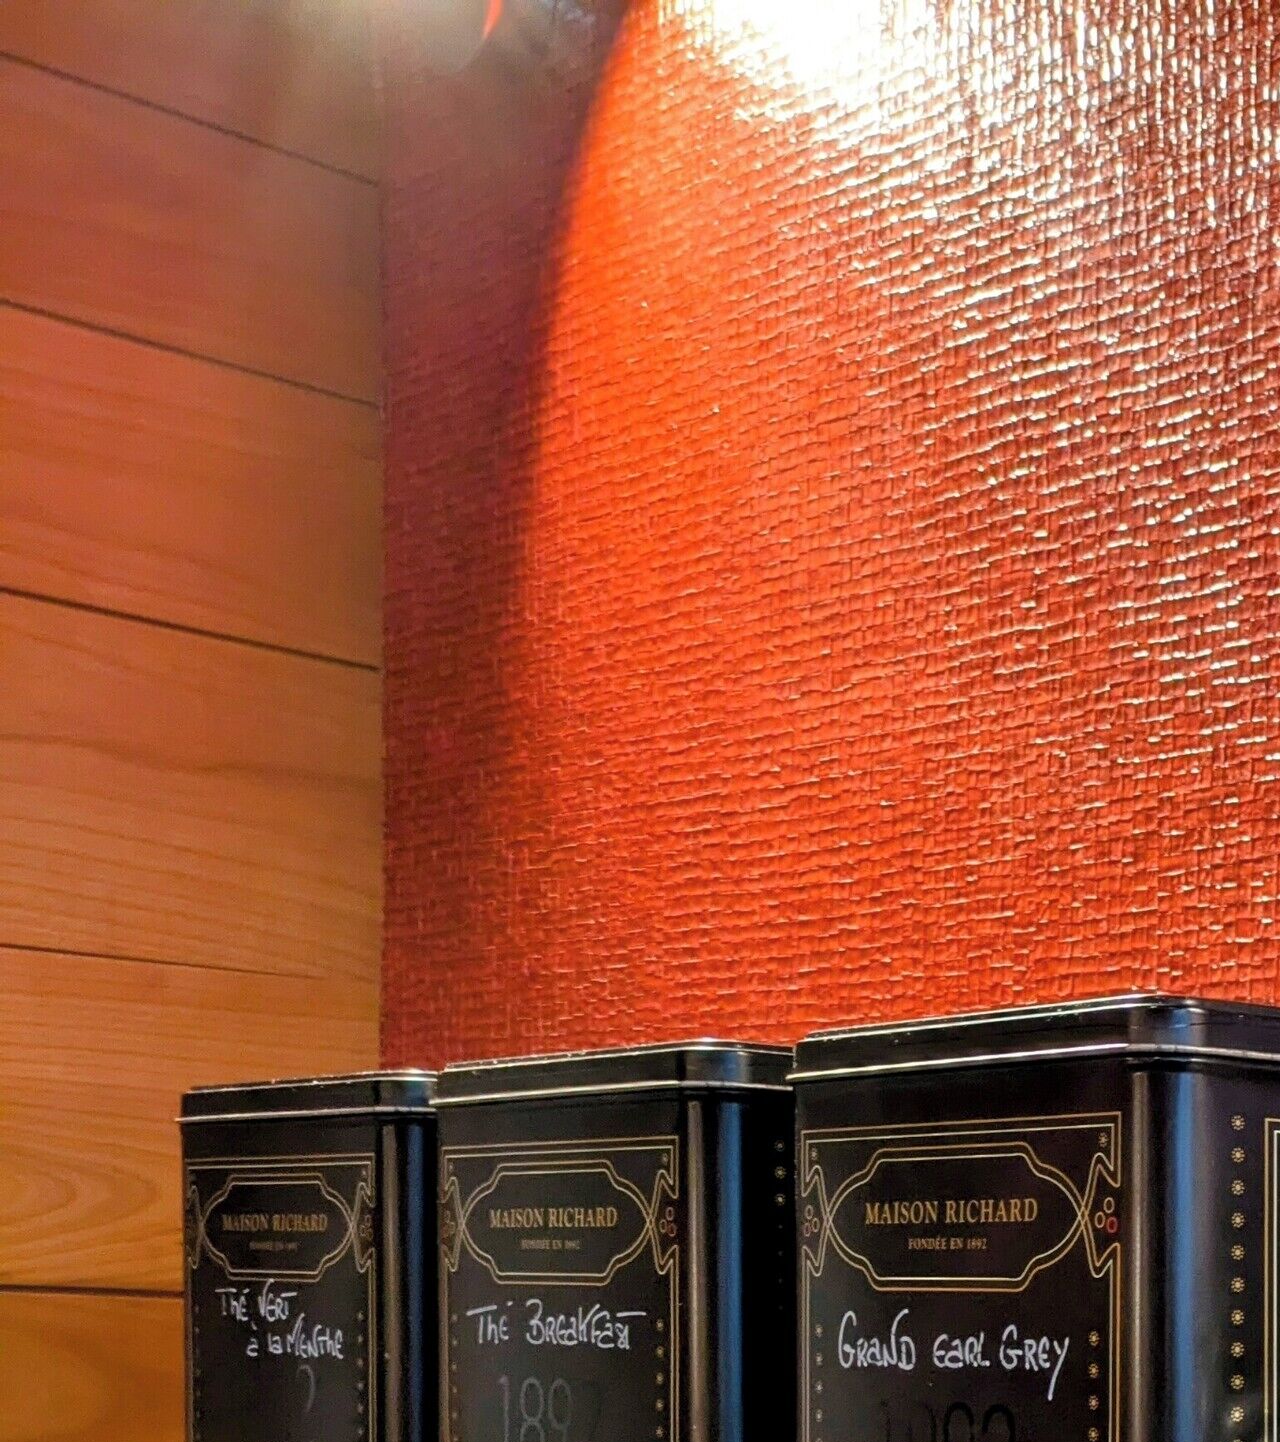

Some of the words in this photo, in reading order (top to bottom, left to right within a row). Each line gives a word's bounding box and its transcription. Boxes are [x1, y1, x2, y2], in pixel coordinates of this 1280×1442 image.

[490, 1207, 544, 1228] MAISON
[549, 1207, 618, 1228] RICHARD
[865, 1200, 938, 1225] MAISON
[945, 1198, 1038, 1223] RICHARD
[223, 1214, 268, 1231] MAISON
[273, 1214, 328, 1231] RICHARD
[950, 1237, 963, 1249] EN
